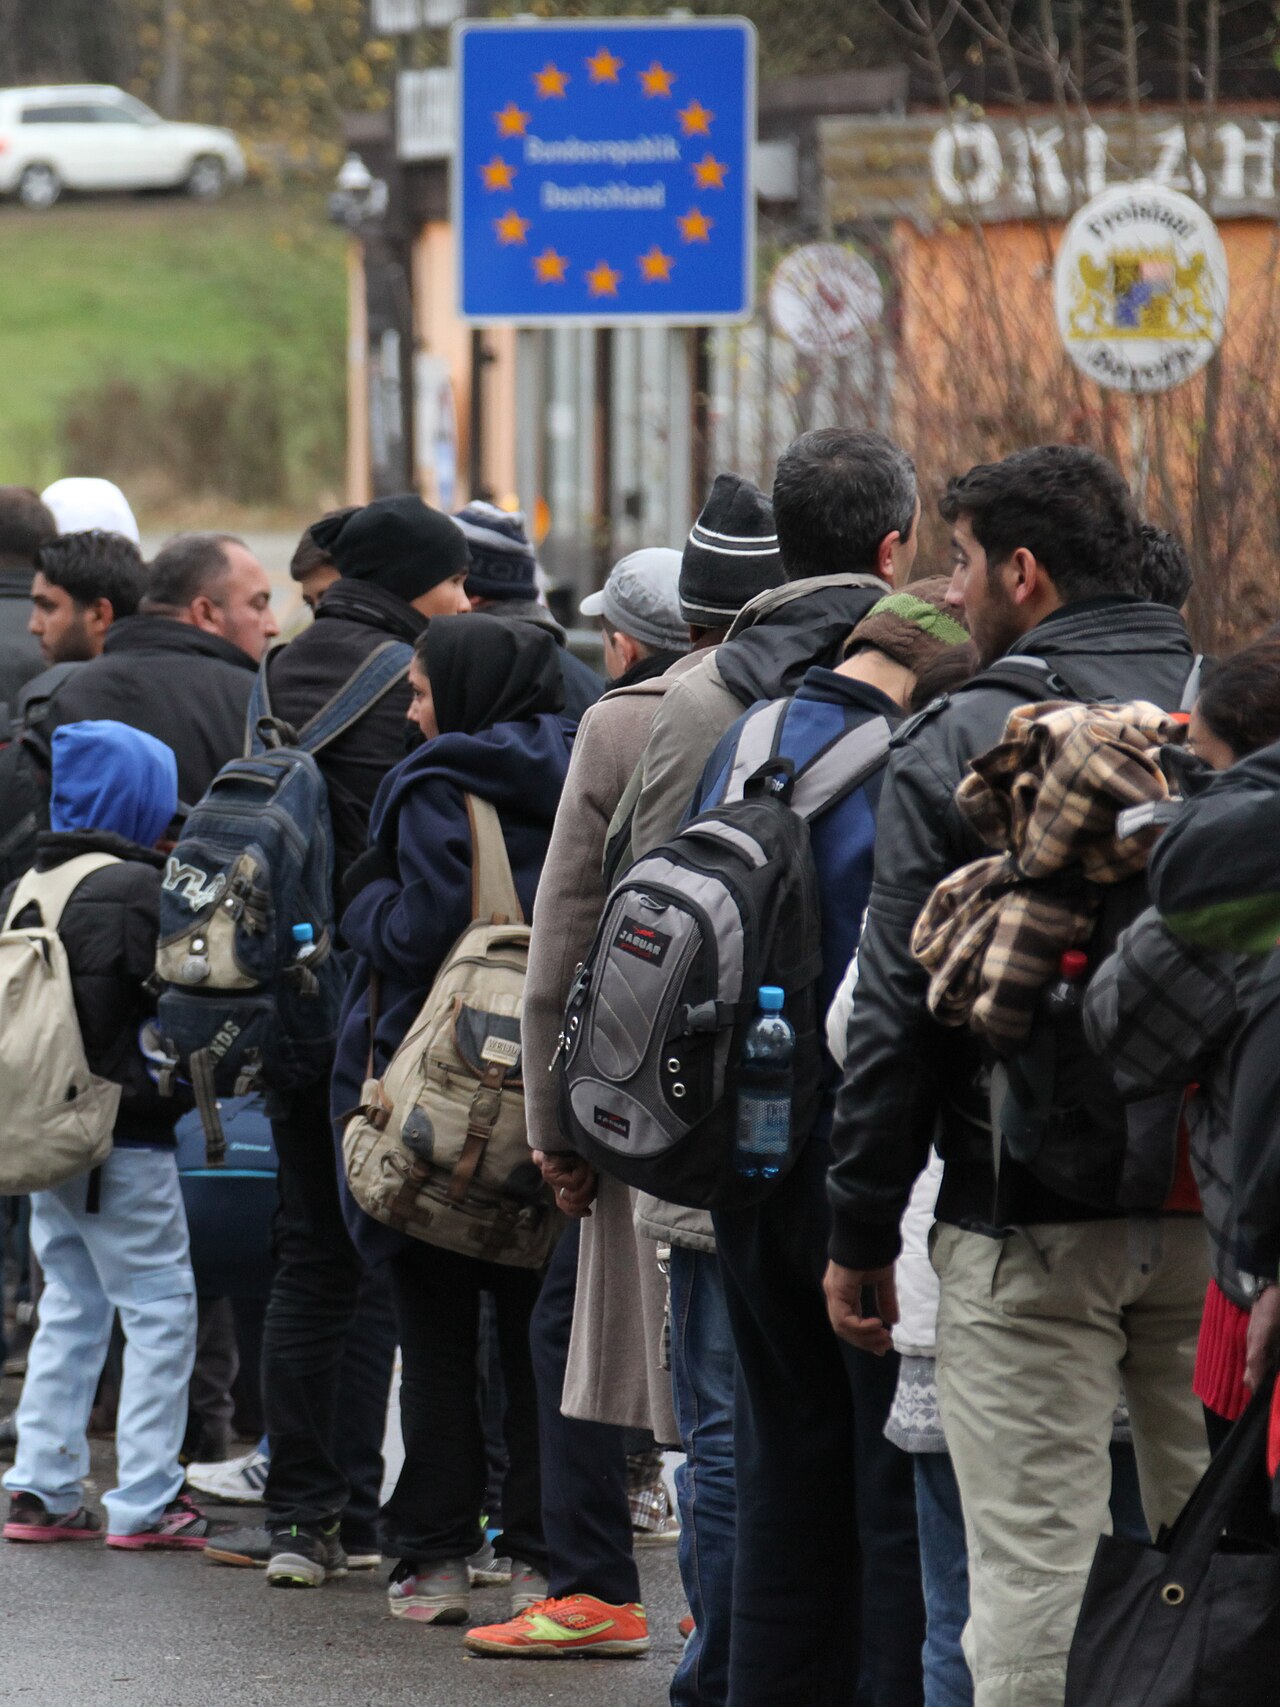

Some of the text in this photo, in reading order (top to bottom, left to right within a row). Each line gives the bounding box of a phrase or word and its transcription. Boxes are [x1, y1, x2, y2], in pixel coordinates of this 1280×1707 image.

[524, 135, 681, 167] Bundesrepublik
[541, 180, 666, 211] Deutschland
[619, 930, 662, 955] JAGUAR
